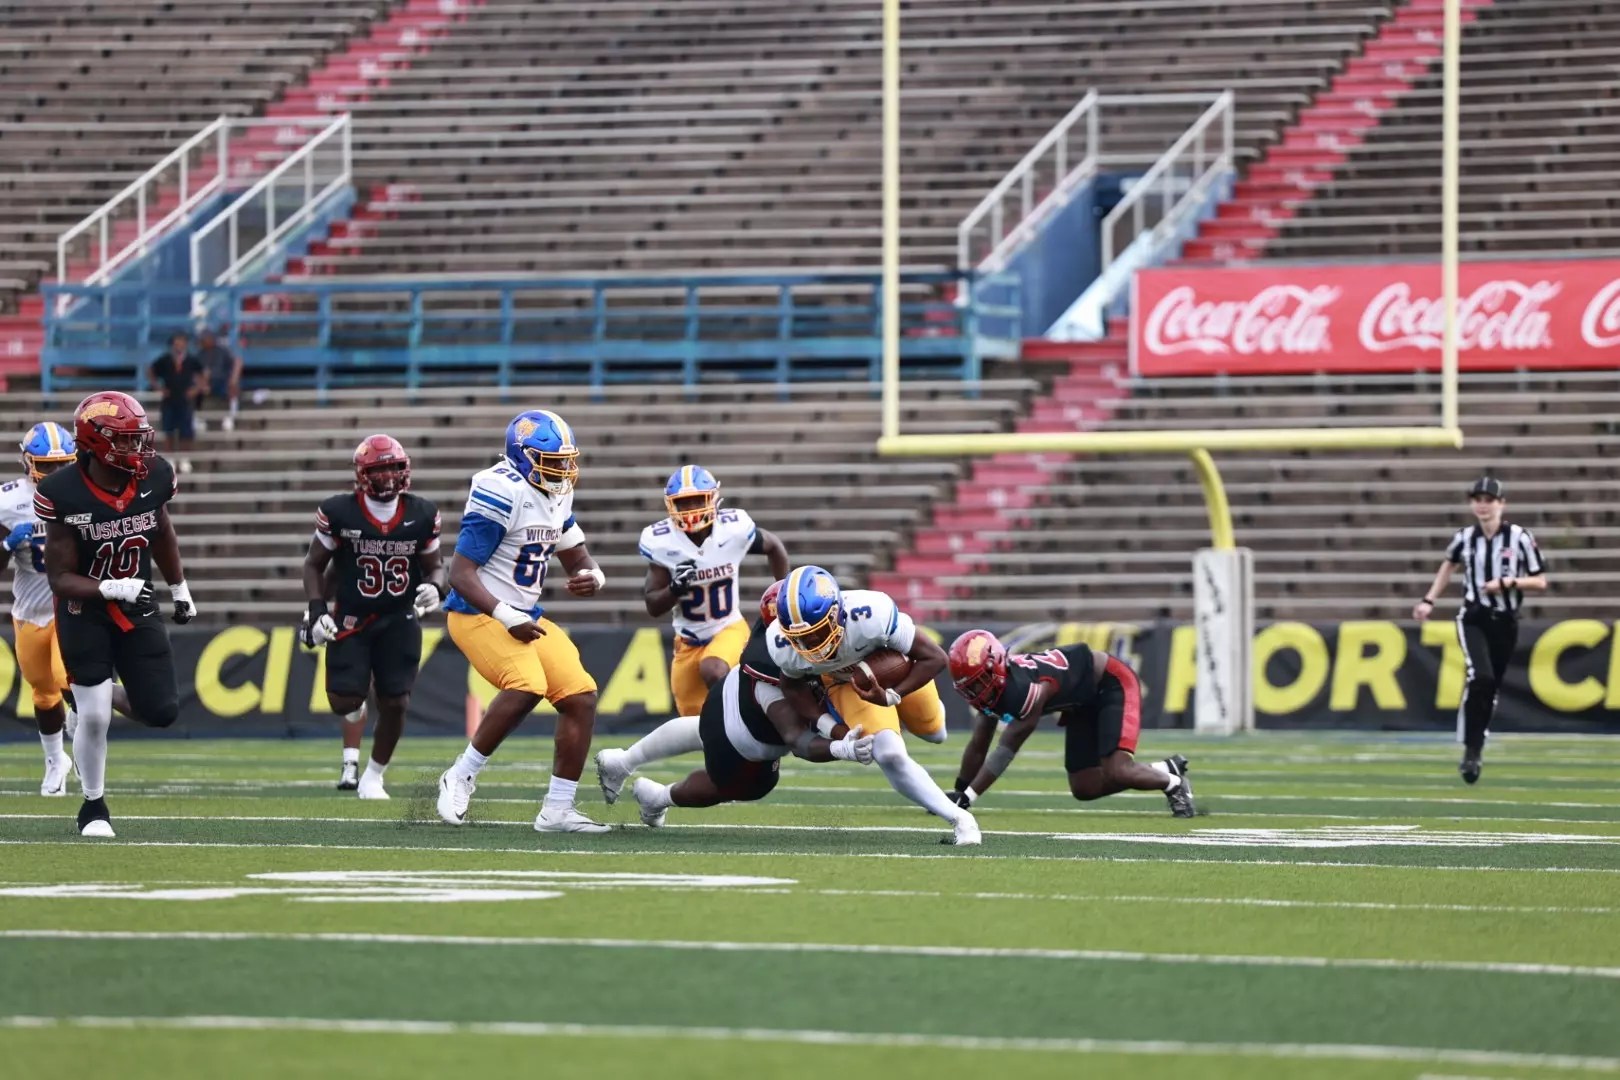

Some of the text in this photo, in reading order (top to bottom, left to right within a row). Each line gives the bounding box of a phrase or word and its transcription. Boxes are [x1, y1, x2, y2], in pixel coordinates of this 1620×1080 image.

[78, 510, 158, 541] TUSKEGEE
[526, 526, 562, 541] WILDCA
[88, 535, 149, 580] 10
[351, 539, 417, 555] TUSKEGEE
[356, 555, 410, 598] 33
[697, 562, 735, 581] DCATS
[681, 577, 734, 622] 20
[850, 604, 873, 622] 3
